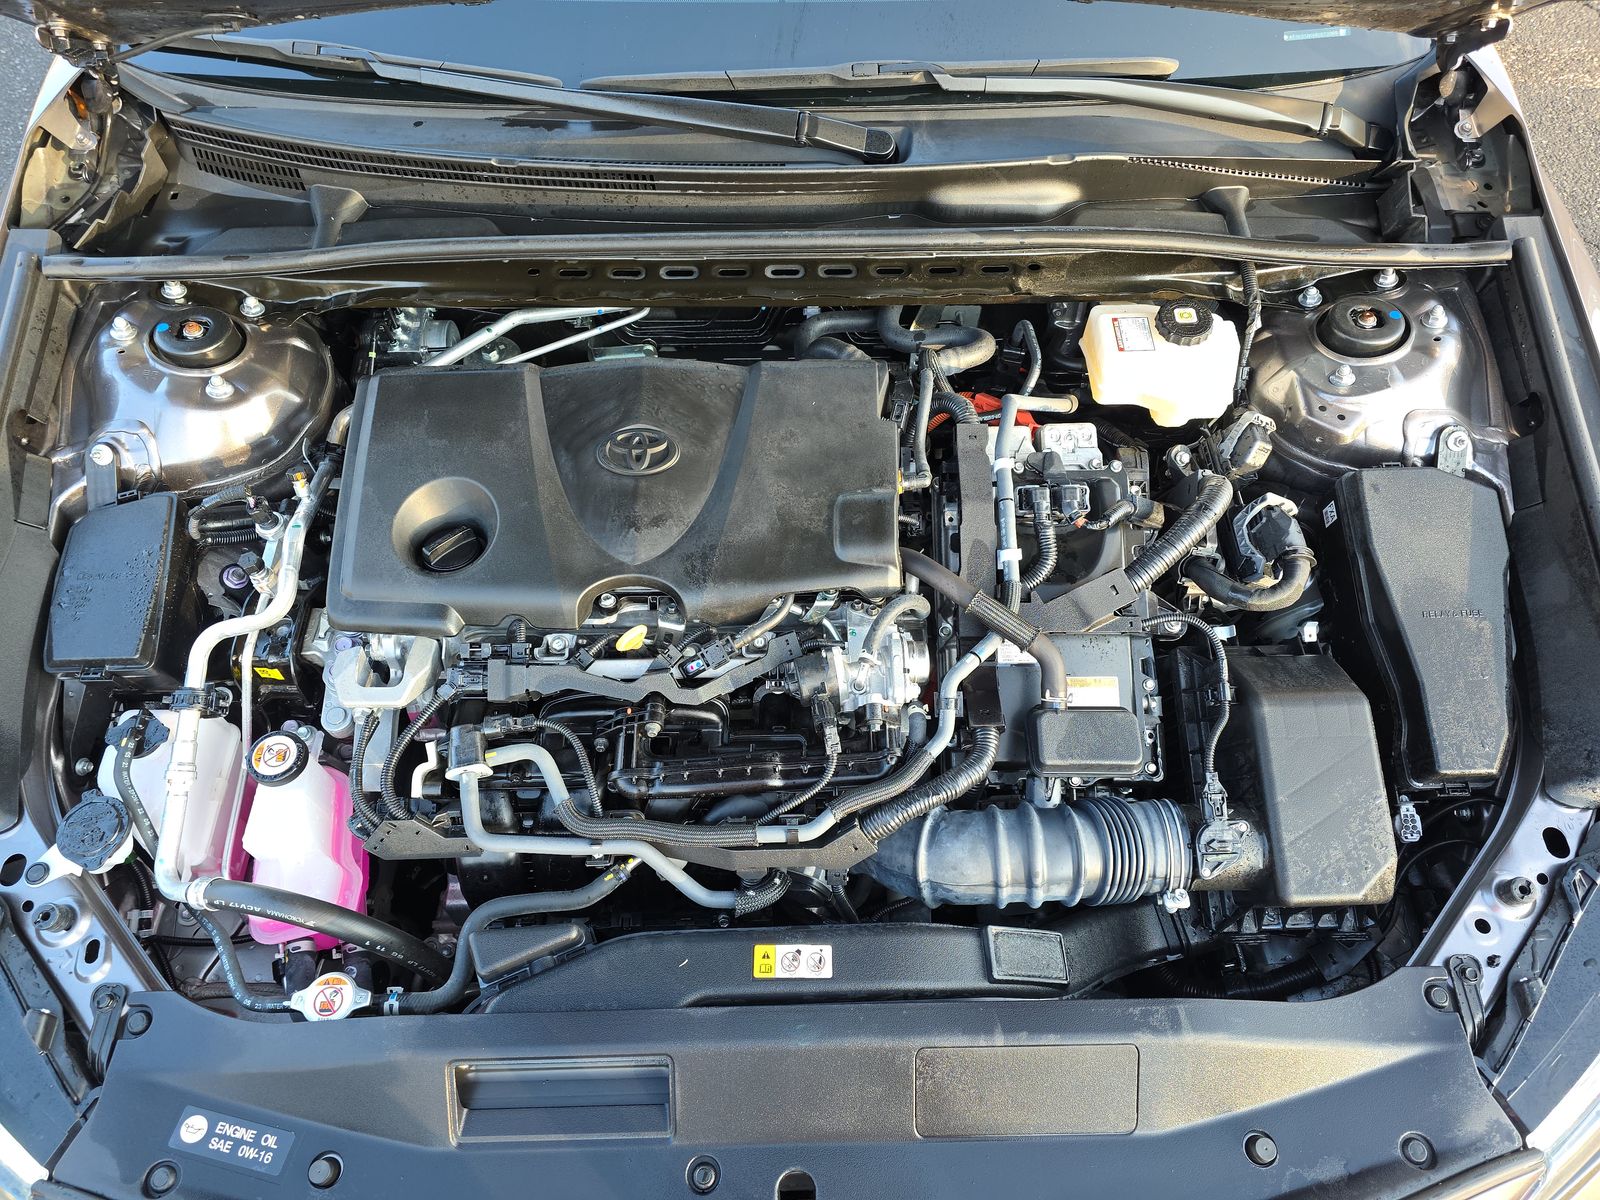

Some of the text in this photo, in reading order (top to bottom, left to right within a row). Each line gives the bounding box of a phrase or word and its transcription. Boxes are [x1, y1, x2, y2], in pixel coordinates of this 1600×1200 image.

[1460, 608, 1484, 618] FUSE
[229, 901, 262, 913] ACV17
[266, 909, 306, 924] YOKOHAMA
[215, 1121, 279, 1150] ENGINE OIL
[208, 1136, 274, 1164] SAE 0W-16
